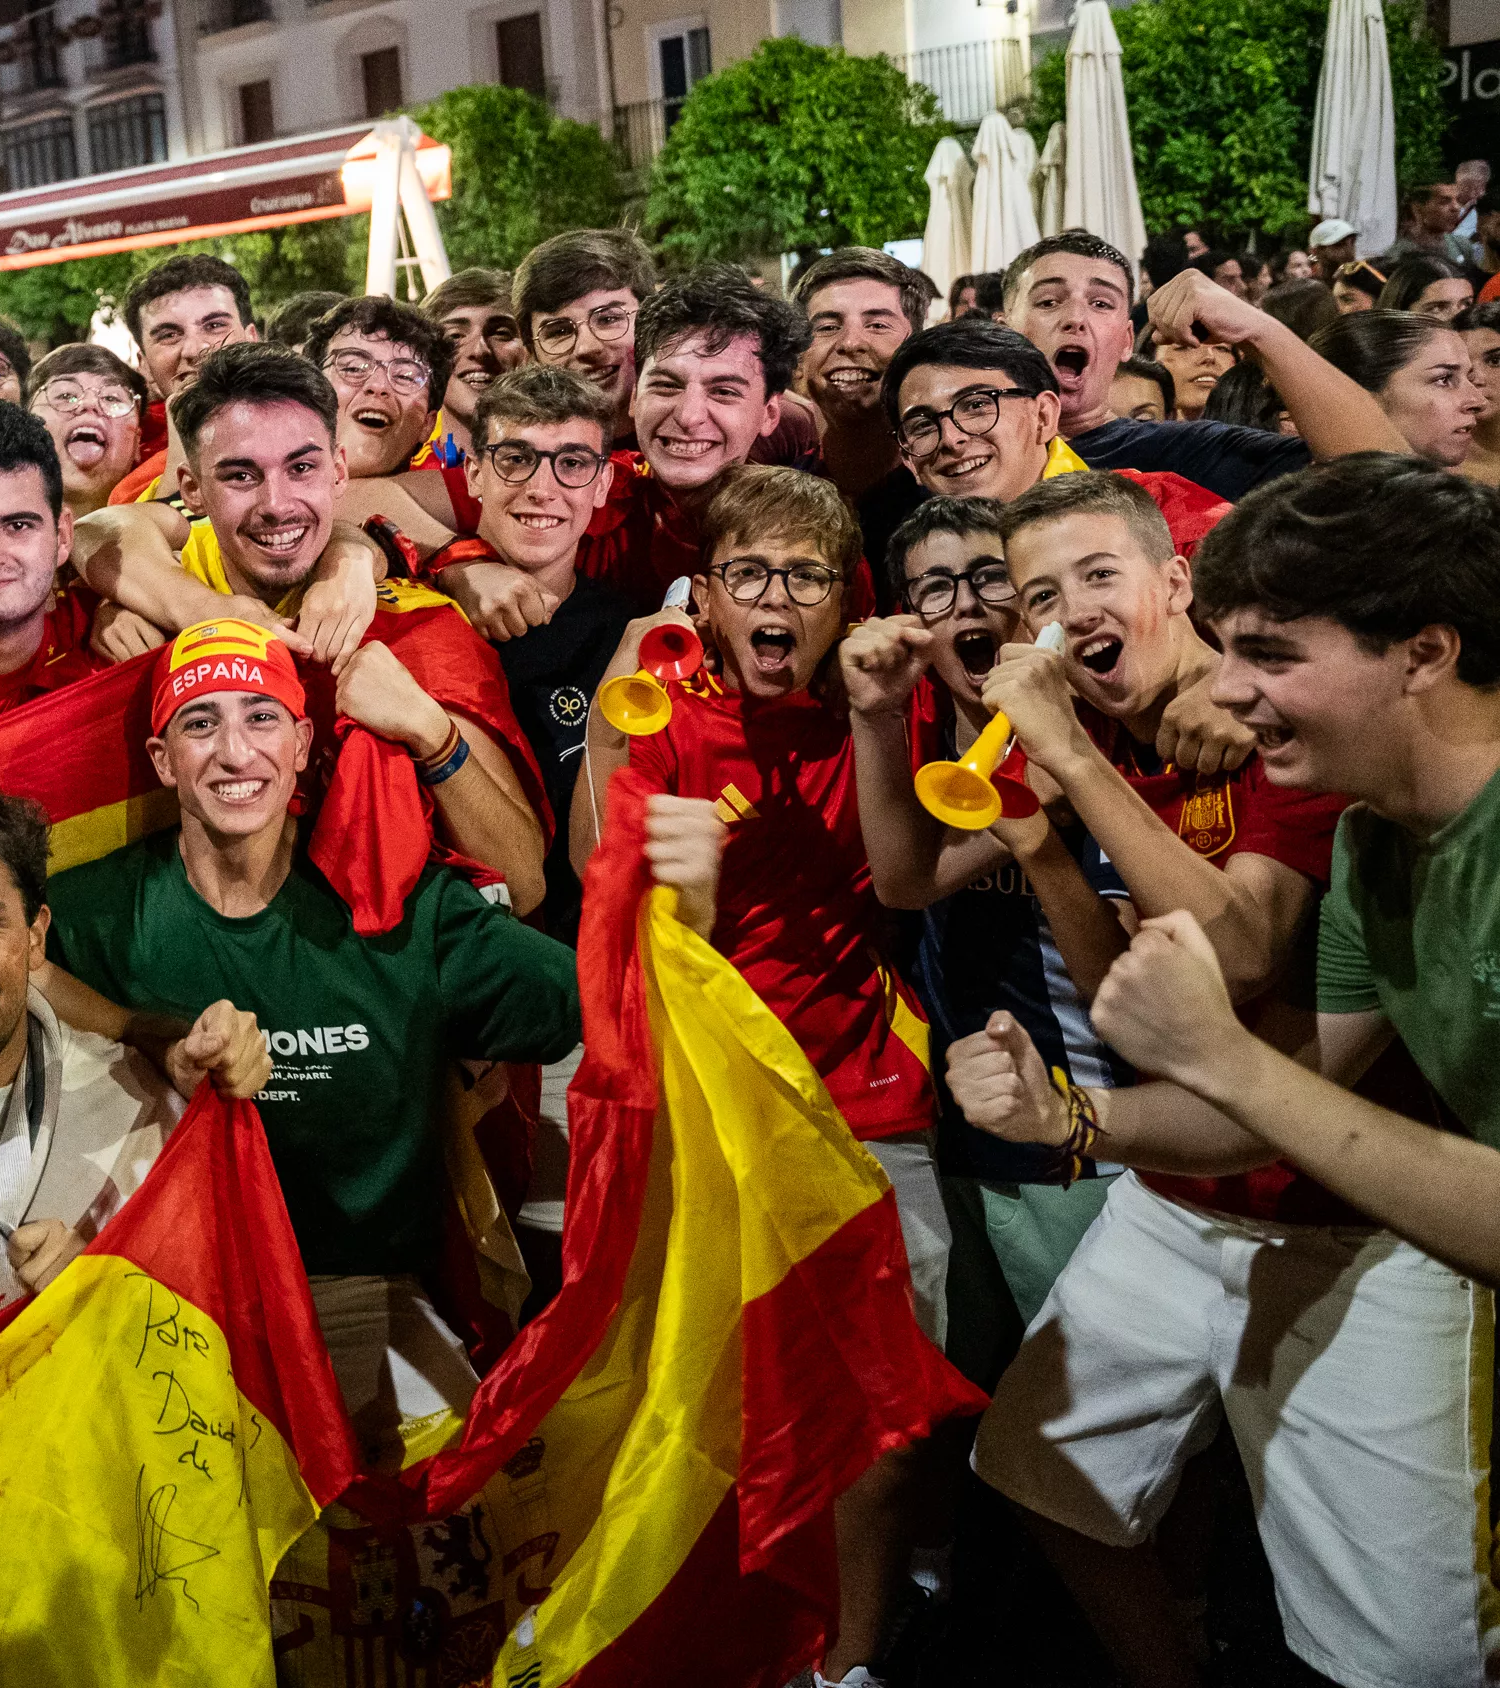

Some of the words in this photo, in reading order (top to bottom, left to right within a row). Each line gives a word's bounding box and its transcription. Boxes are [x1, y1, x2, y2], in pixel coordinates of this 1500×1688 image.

[171, 658, 265, 697] ESPAÑA
[268, 1072, 333, 1081] ON_APPAREL
[258, 1091, 301, 1102] DEPT.
